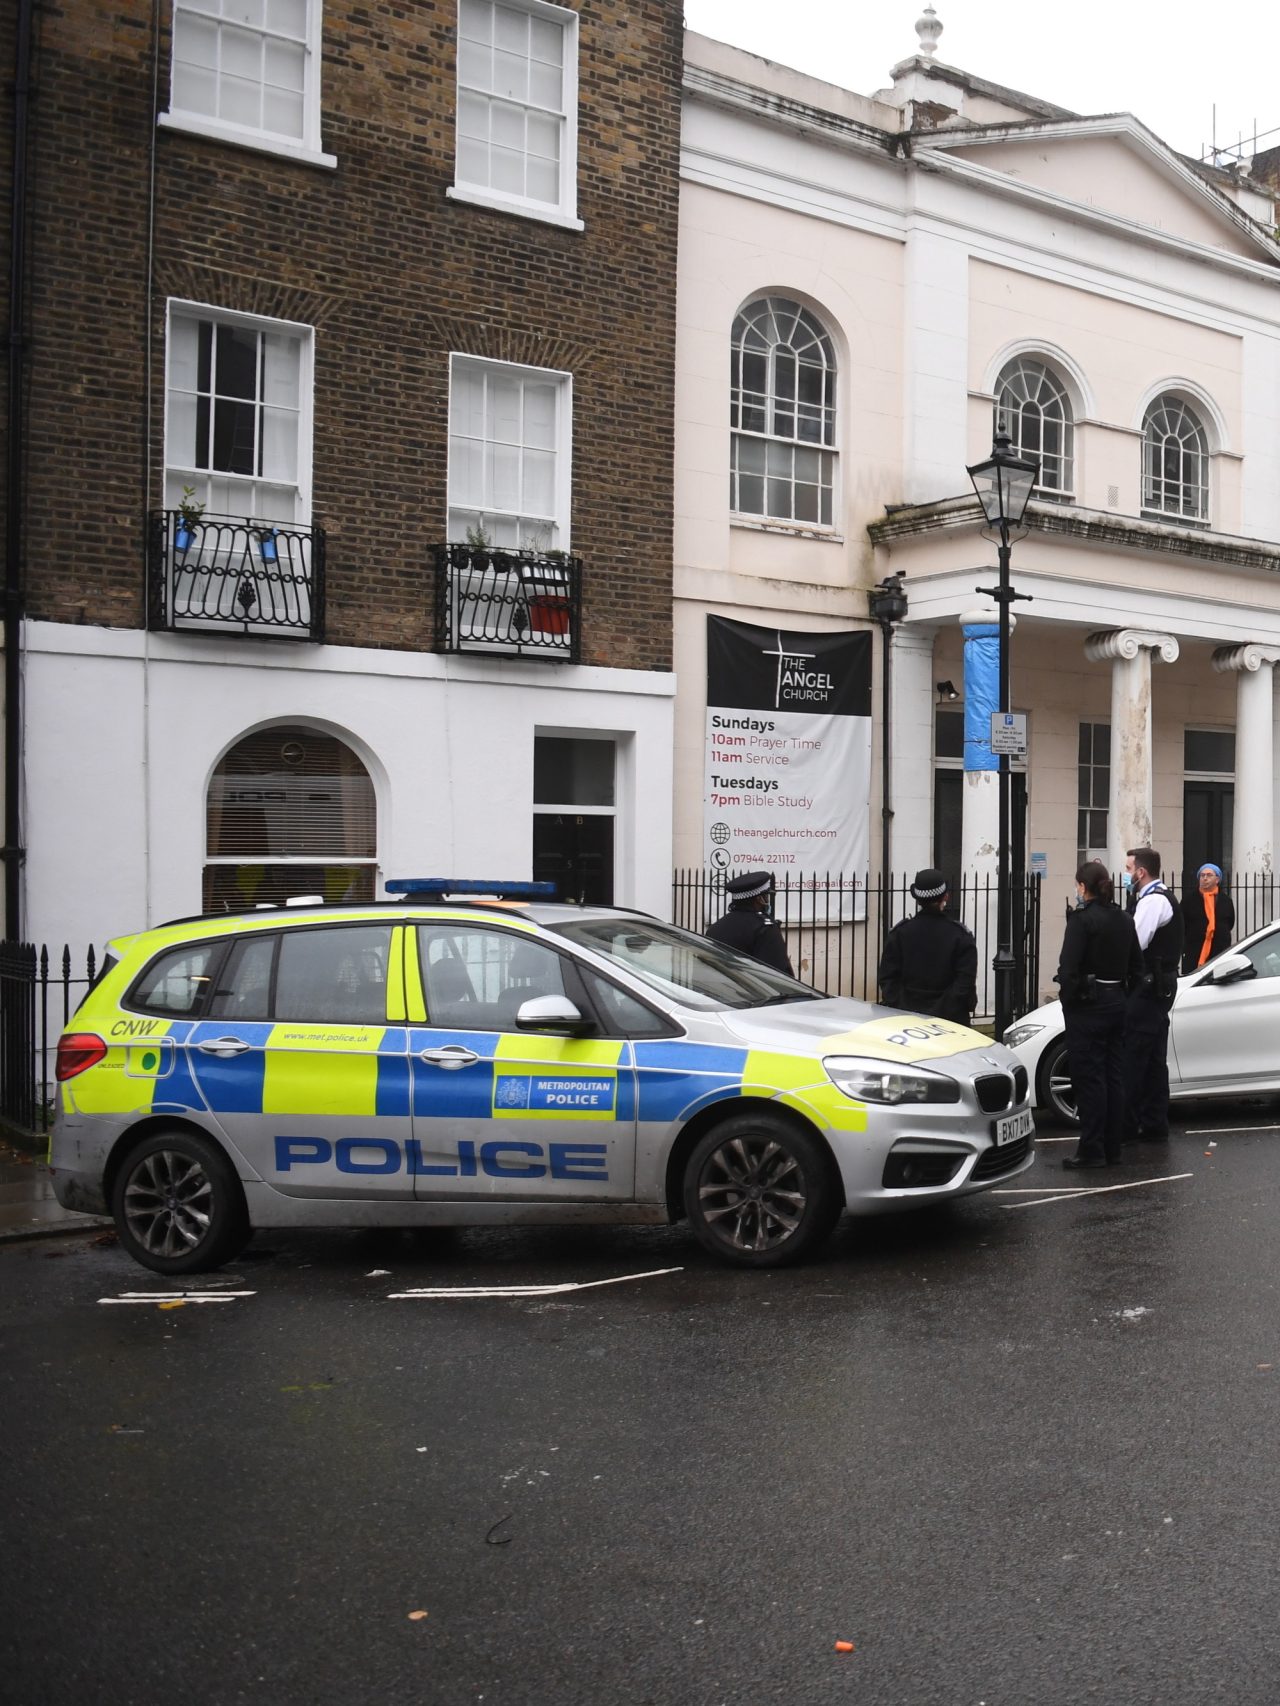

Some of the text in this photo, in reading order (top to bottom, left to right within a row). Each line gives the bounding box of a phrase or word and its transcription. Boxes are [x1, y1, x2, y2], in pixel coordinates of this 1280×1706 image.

[783, 657, 806, 671] THE
[782, 671, 834, 689] ANGEL
[783, 688, 828, 701] CHURCH
[711, 715, 775, 734] Sundays
[711, 733, 822, 751] 10am Prayer Time
[711, 751, 790, 766] 11am Service
[711, 775, 779, 793] Tuesdays
[711, 793, 814, 810] 7pm Bible Study
[576, 815, 584, 825] B
[733, 828, 838, 840] theangelchurch.com
[733, 854, 796, 864] 07944 221112
[110, 1020, 160, 1036] CNW
[283, 1032, 369, 1042] www.met.police.uk
[537, 1081, 611, 1091] METROPOLITAN
[546, 1093, 599, 1105] POLICE
[1002, 1117, 1019, 1143] BX17
[274, 1135, 609, 1181] POLICE
